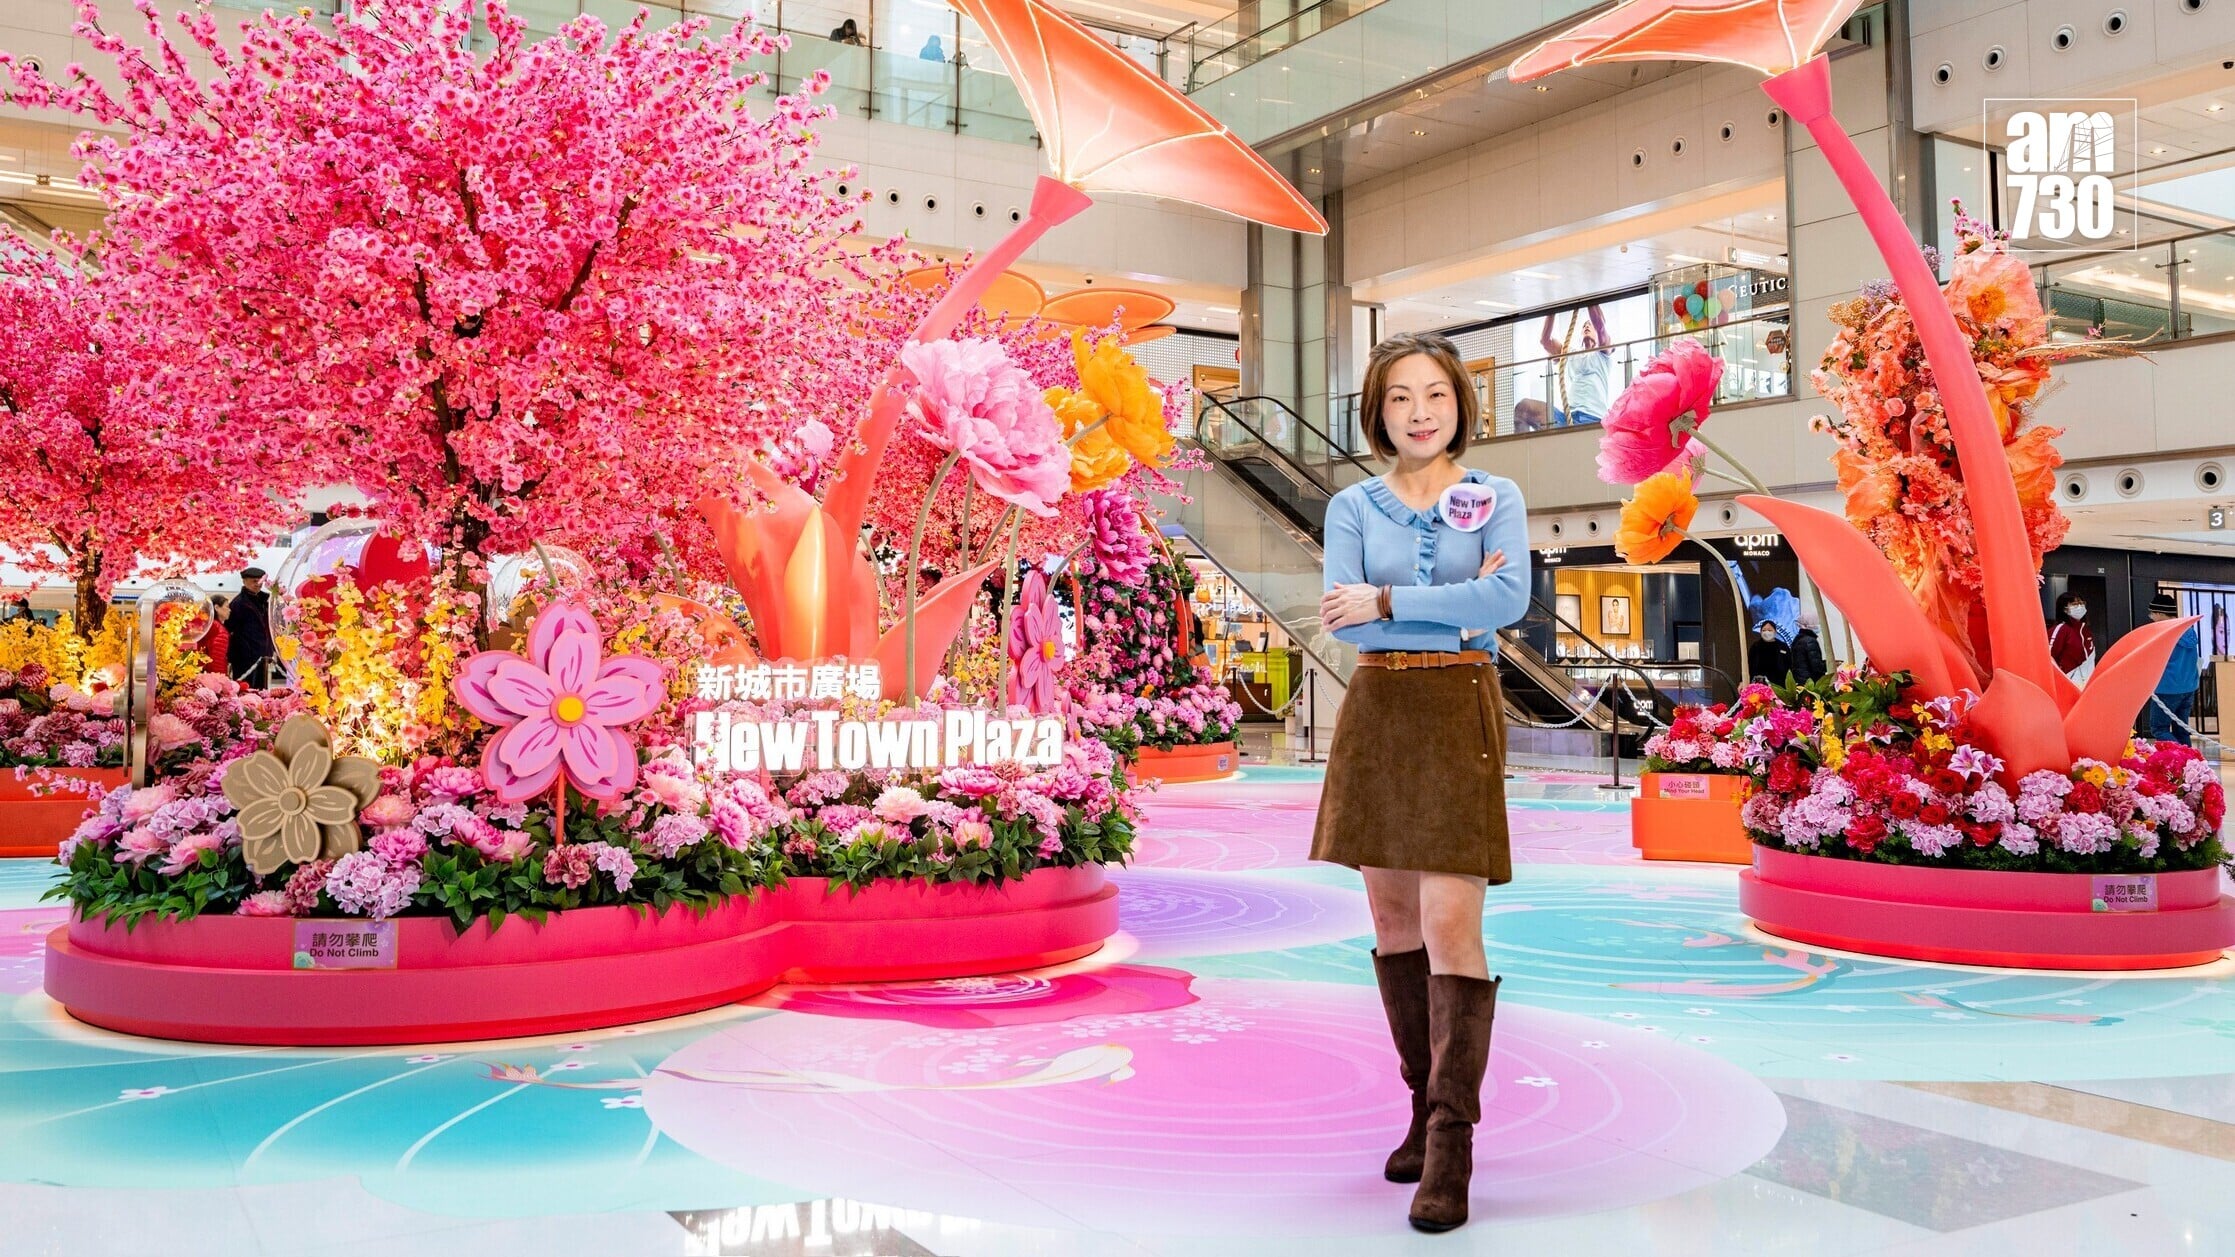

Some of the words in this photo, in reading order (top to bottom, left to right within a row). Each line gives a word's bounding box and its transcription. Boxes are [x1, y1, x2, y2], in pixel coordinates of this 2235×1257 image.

[1450, 496, 1468, 508] New
[1471, 497, 1492, 508] Town
[1449, 508, 1472, 519] Plaza
[2210, 512, 2223, 527] 3
[1734, 534, 1779, 550] apm
[697, 664, 881, 700] 新城市廣場
[695, 711, 808, 771] New
[811, 710, 938, 769] Town
[945, 709, 1062, 767] Plaza
[2105, 884, 2147, 895] 請勿攀爬
[312, 932, 378, 948] 請勿攀爬
[310, 948, 324, 957] Do
[327, 948, 345, 957] Not
[348, 948, 379, 957] Climb
